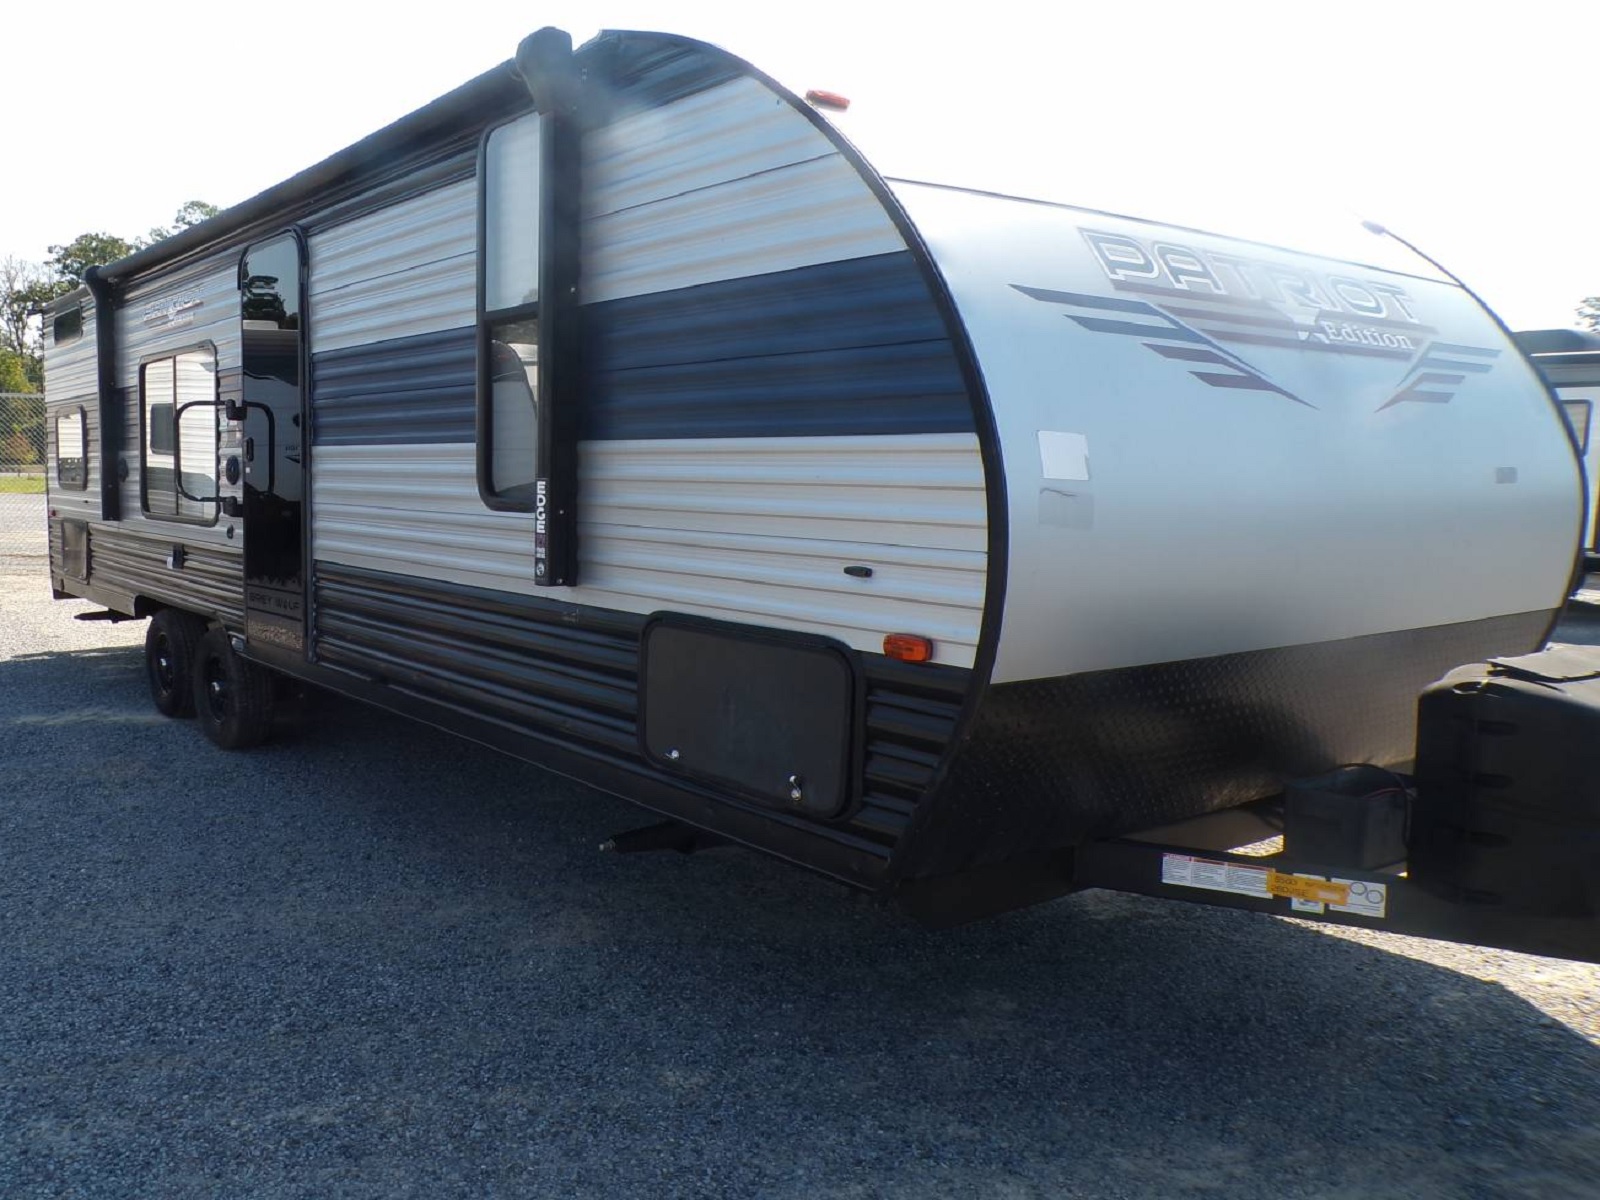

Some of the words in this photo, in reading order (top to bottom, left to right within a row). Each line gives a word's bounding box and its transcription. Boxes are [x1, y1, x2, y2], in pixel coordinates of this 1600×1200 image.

[1077, 227, 1420, 324] PATRIOT
[1324, 321, 1415, 351] Edition
[536, 480, 546, 534] EDGE
